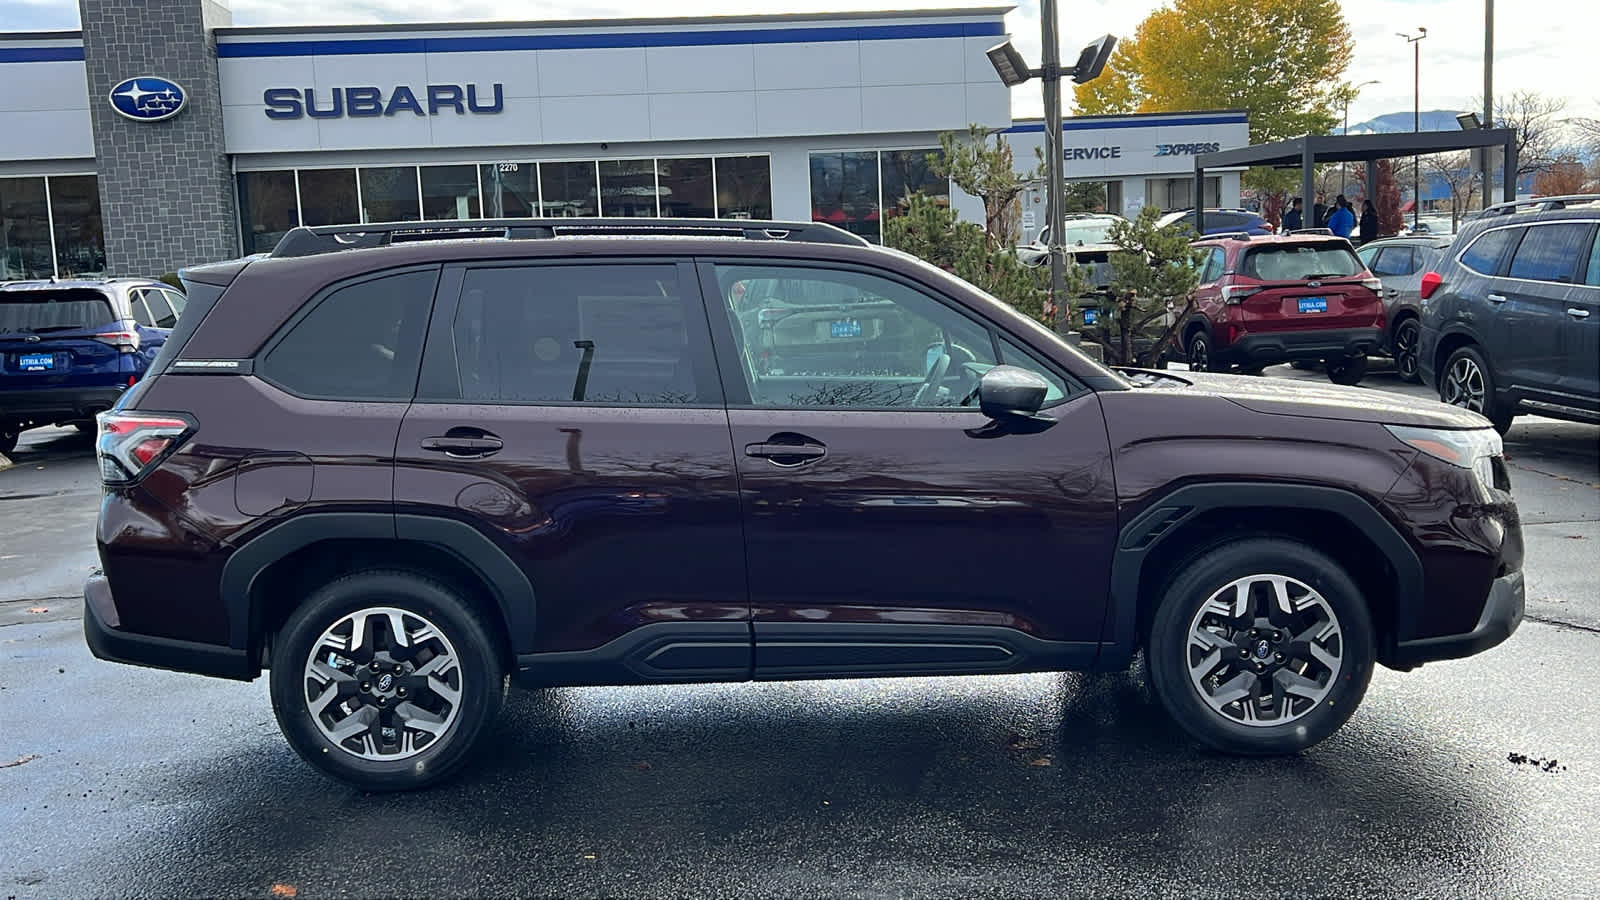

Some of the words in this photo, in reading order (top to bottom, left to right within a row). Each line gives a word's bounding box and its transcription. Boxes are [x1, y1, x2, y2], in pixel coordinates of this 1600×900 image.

[263, 84, 503, 119] SUBARU
[1063, 147, 1121, 160] ERVICE
[1153, 142, 1220, 157] EXPRESS
[499, 163, 518, 172] 2270
